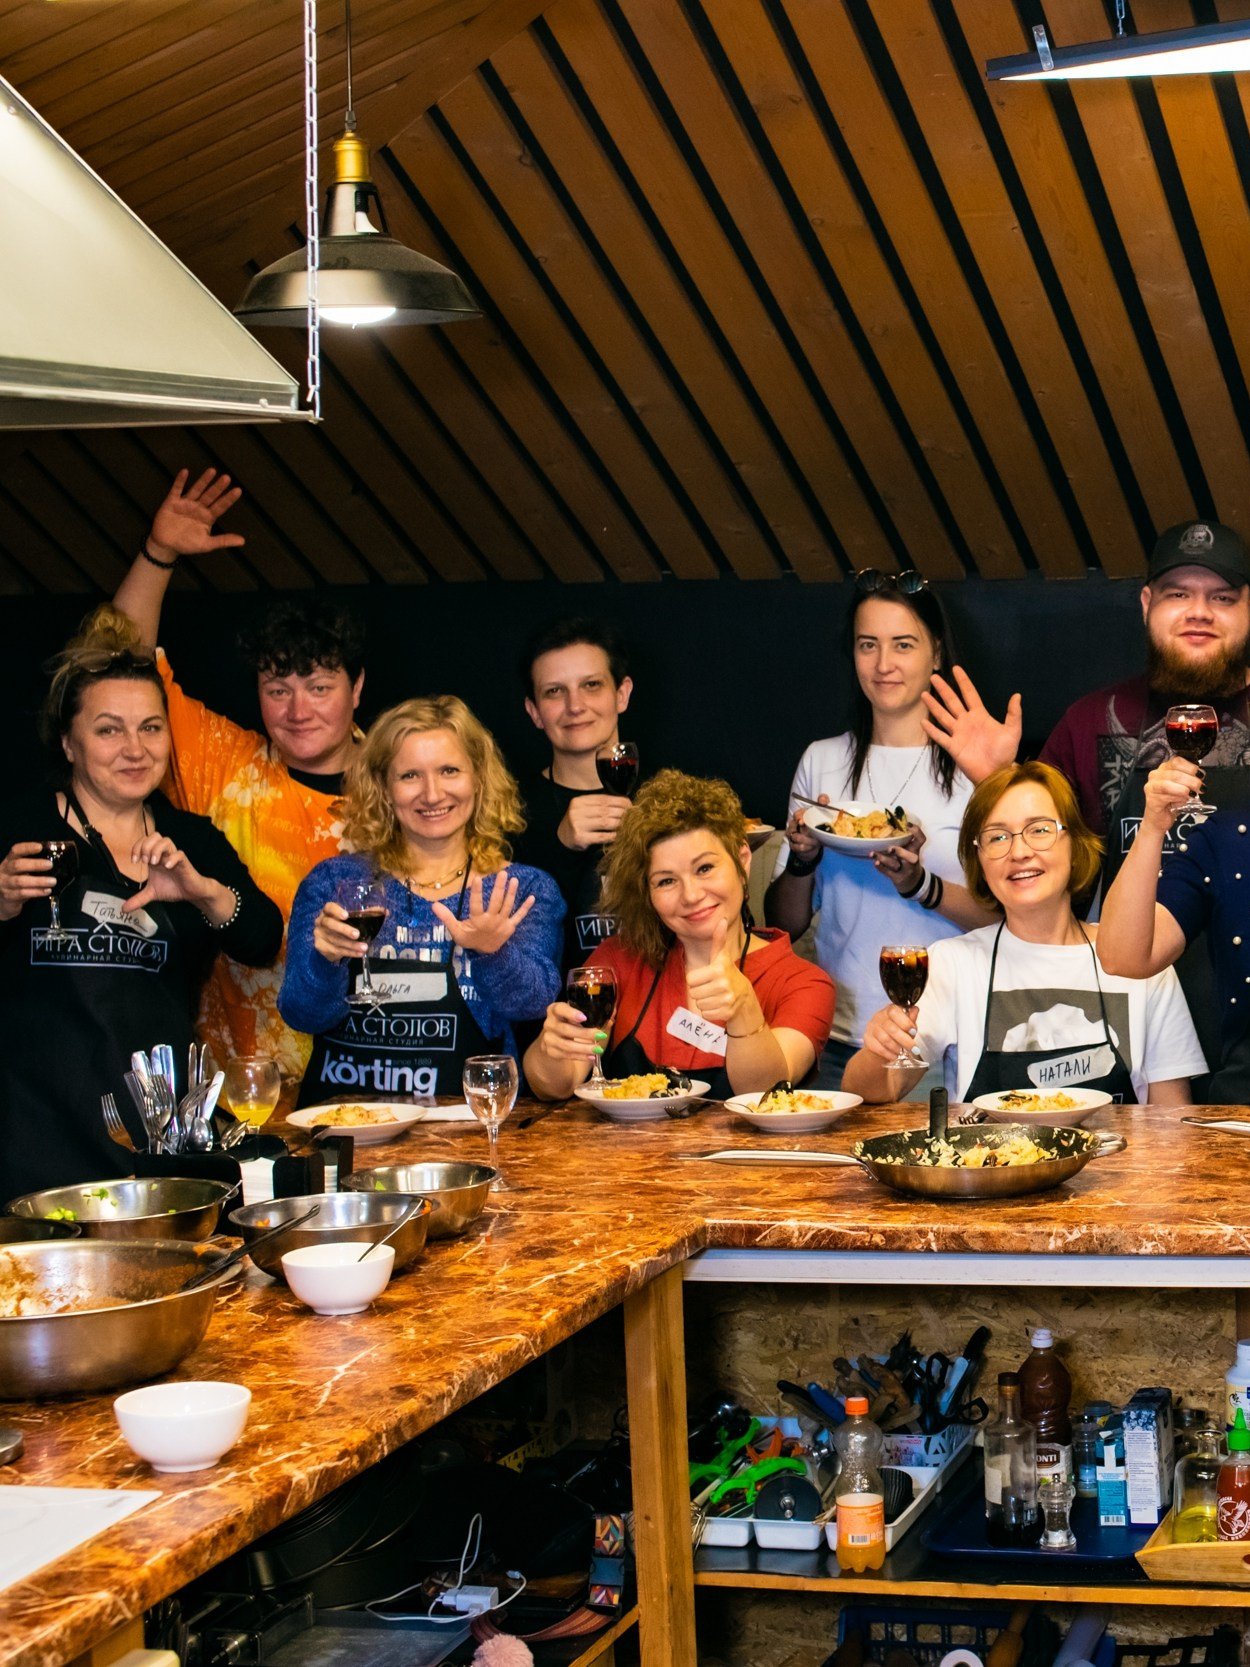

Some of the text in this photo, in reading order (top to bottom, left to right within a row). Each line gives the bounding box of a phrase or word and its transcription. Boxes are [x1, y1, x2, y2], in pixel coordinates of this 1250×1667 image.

[580, 918, 622, 936] ИГР
[362, 1016, 450, 1037] СТОЛОВ
[320, 1050, 438, 1096] körting
[1039, 1056, 1091, 1082] НАТАЛИ
[1035, 1453, 1057, 1463] ONTI
